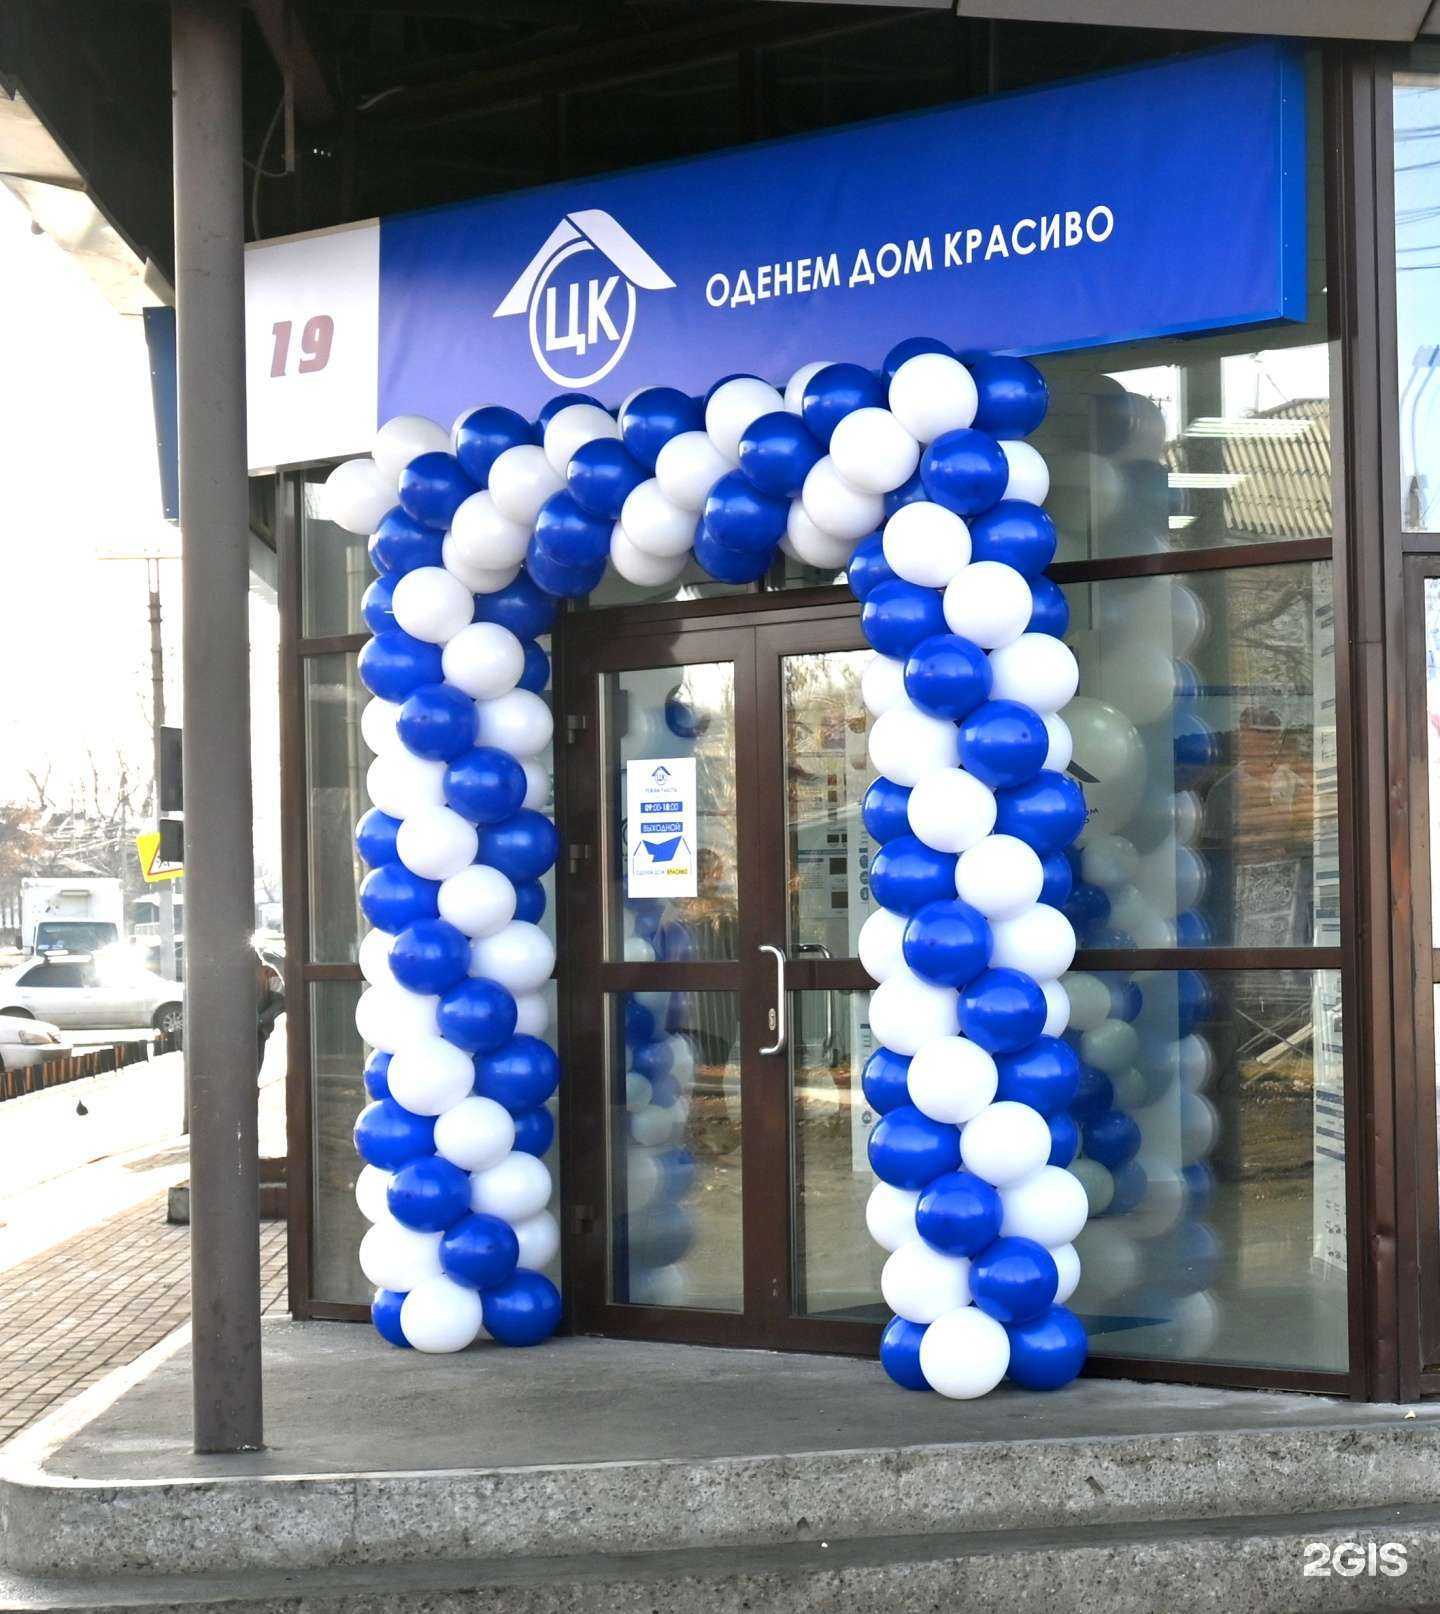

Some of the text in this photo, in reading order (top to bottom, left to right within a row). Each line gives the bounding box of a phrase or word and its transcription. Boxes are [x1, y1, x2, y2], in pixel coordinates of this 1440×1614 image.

[705, 205, 1114, 309] ОДЕНЕМ ДОМ КРАСИВО
[270, 315, 334, 378] 19
[545, 275, 621, 355] ЦК
